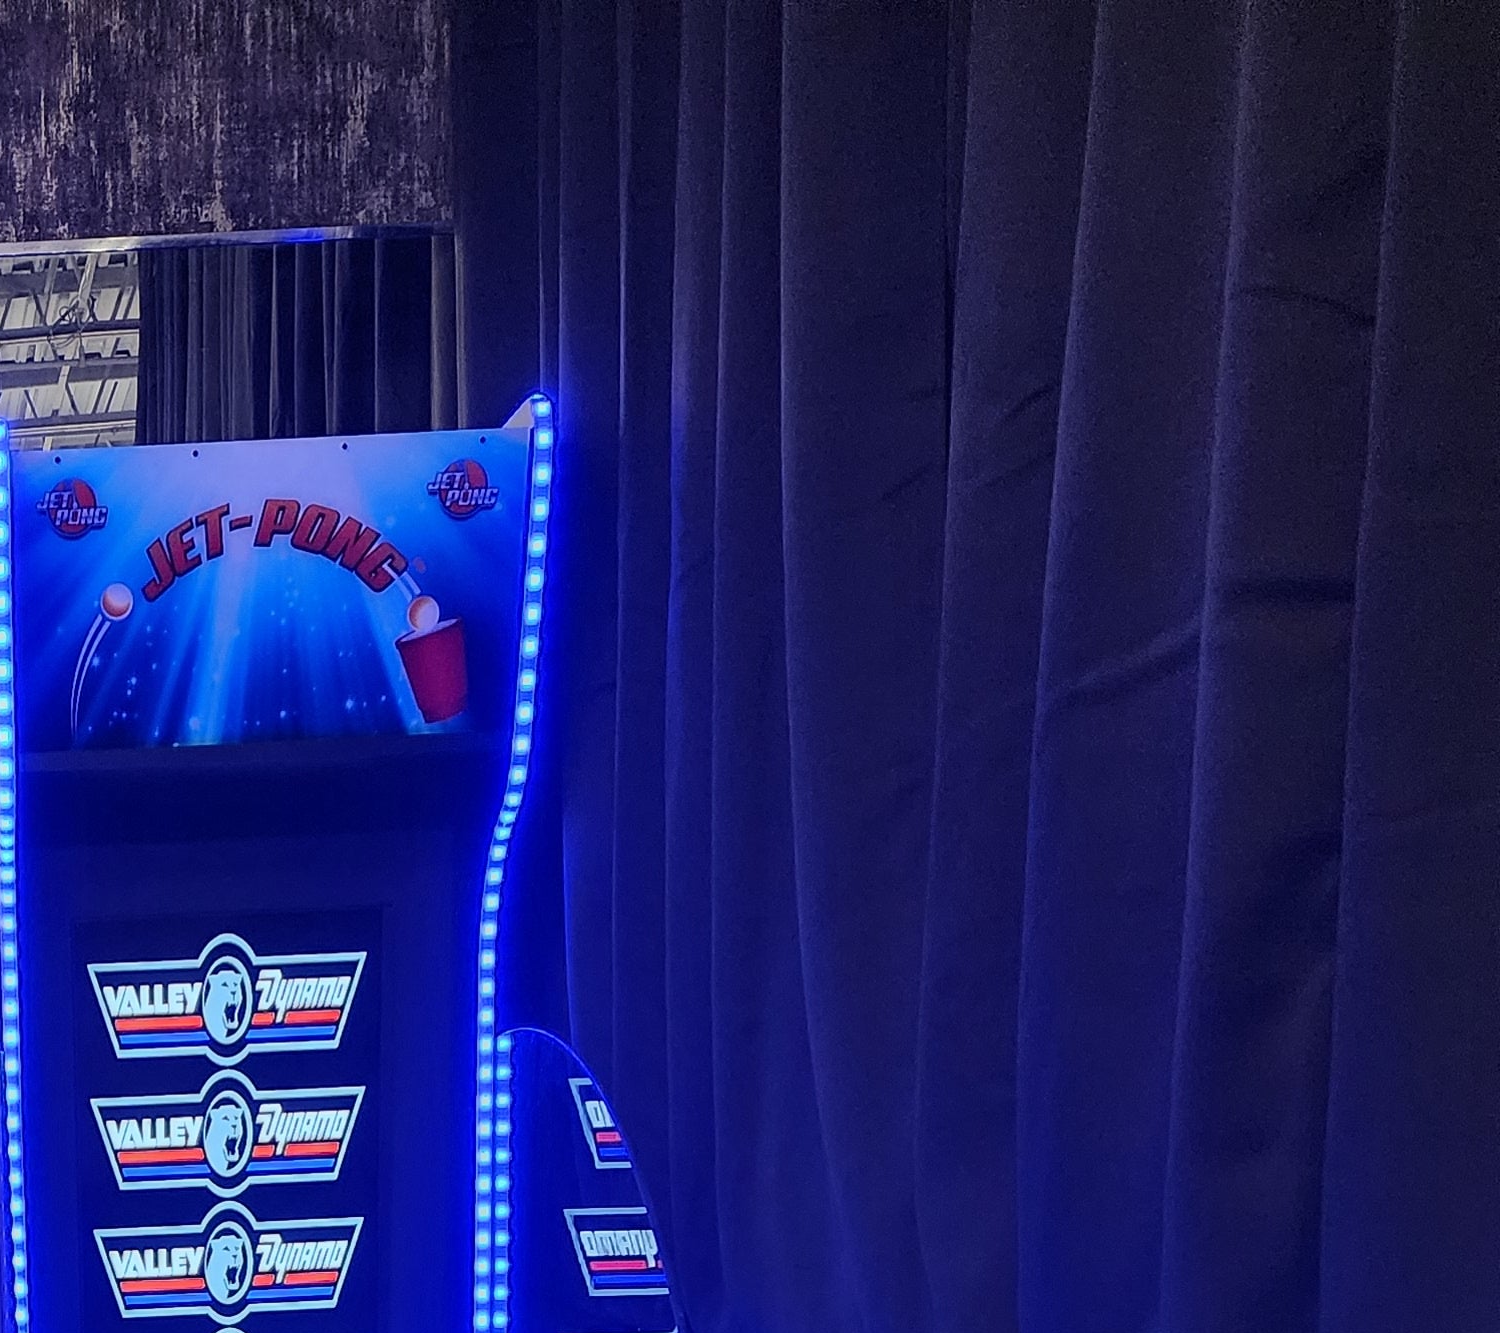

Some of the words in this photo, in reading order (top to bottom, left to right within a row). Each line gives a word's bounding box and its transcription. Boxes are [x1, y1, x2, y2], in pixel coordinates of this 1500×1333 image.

[427, 471, 466, 491] JET
[36, 490, 74, 510] JET
[445, 487, 499, 507] PONG
[54, 506, 108, 526] PONG
[102, 981, 204, 1019] VALLEY
[105, 1115, 205, 1151] VALLEY
[107, 1246, 206, 1280] VALLEY
